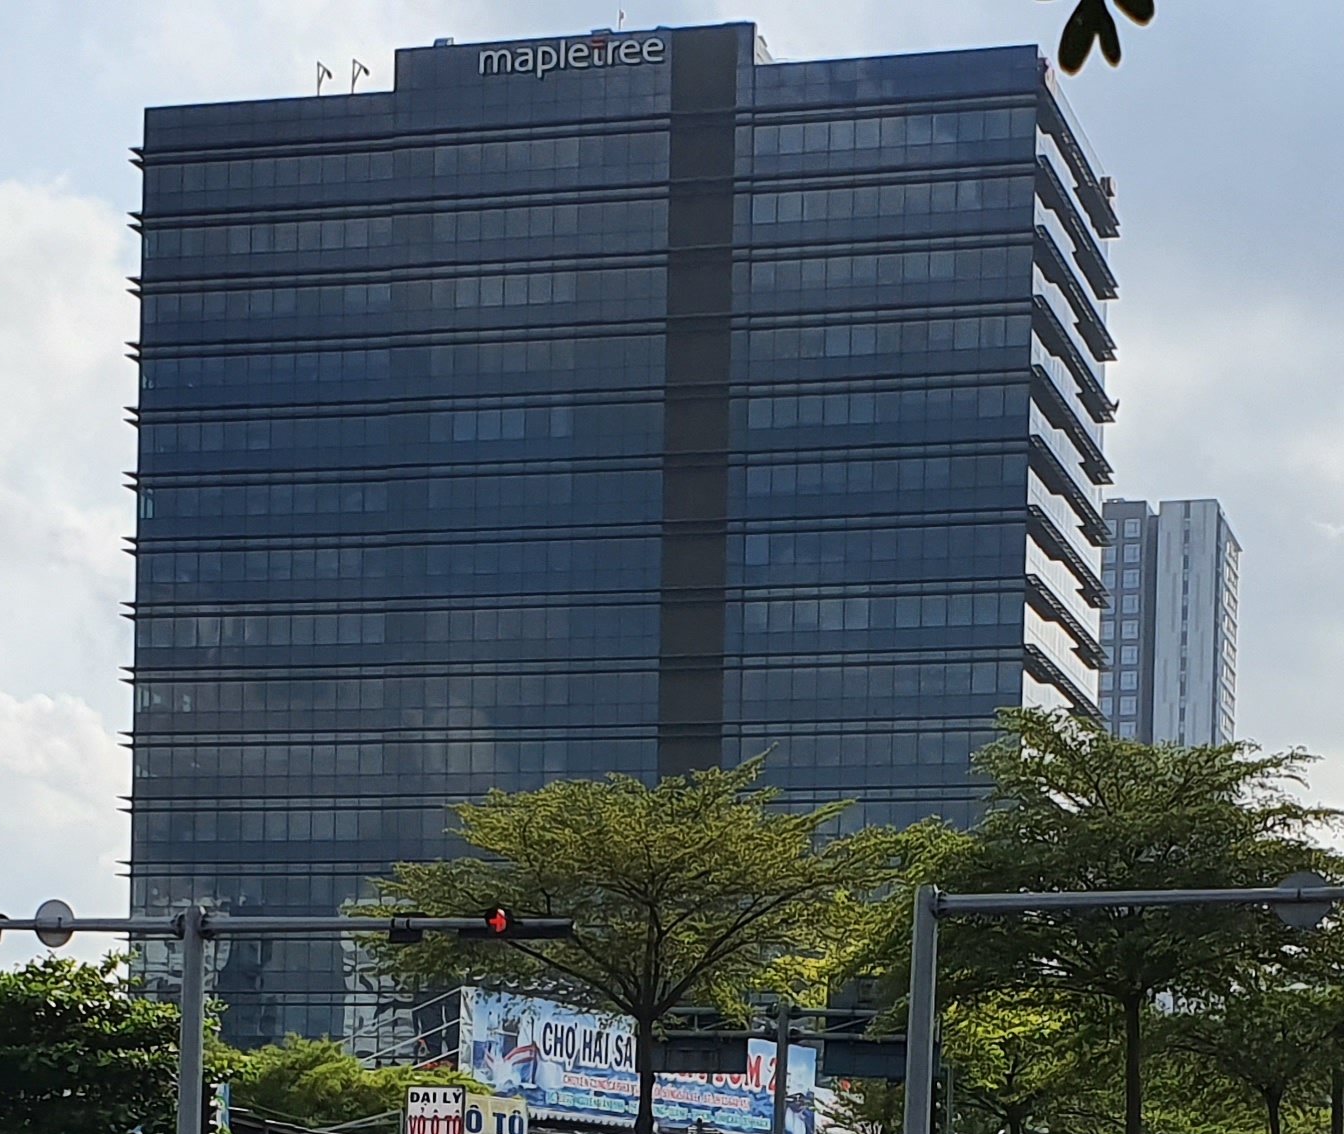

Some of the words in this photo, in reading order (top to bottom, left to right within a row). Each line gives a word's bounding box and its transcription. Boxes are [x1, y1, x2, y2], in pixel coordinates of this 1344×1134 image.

[478, 37, 665, 79] mapletree
[541, 1021, 578, 1067] CHỢ
[442, 1089, 462, 1104] LÝ
[465, 1104, 483, 1134] Ô
